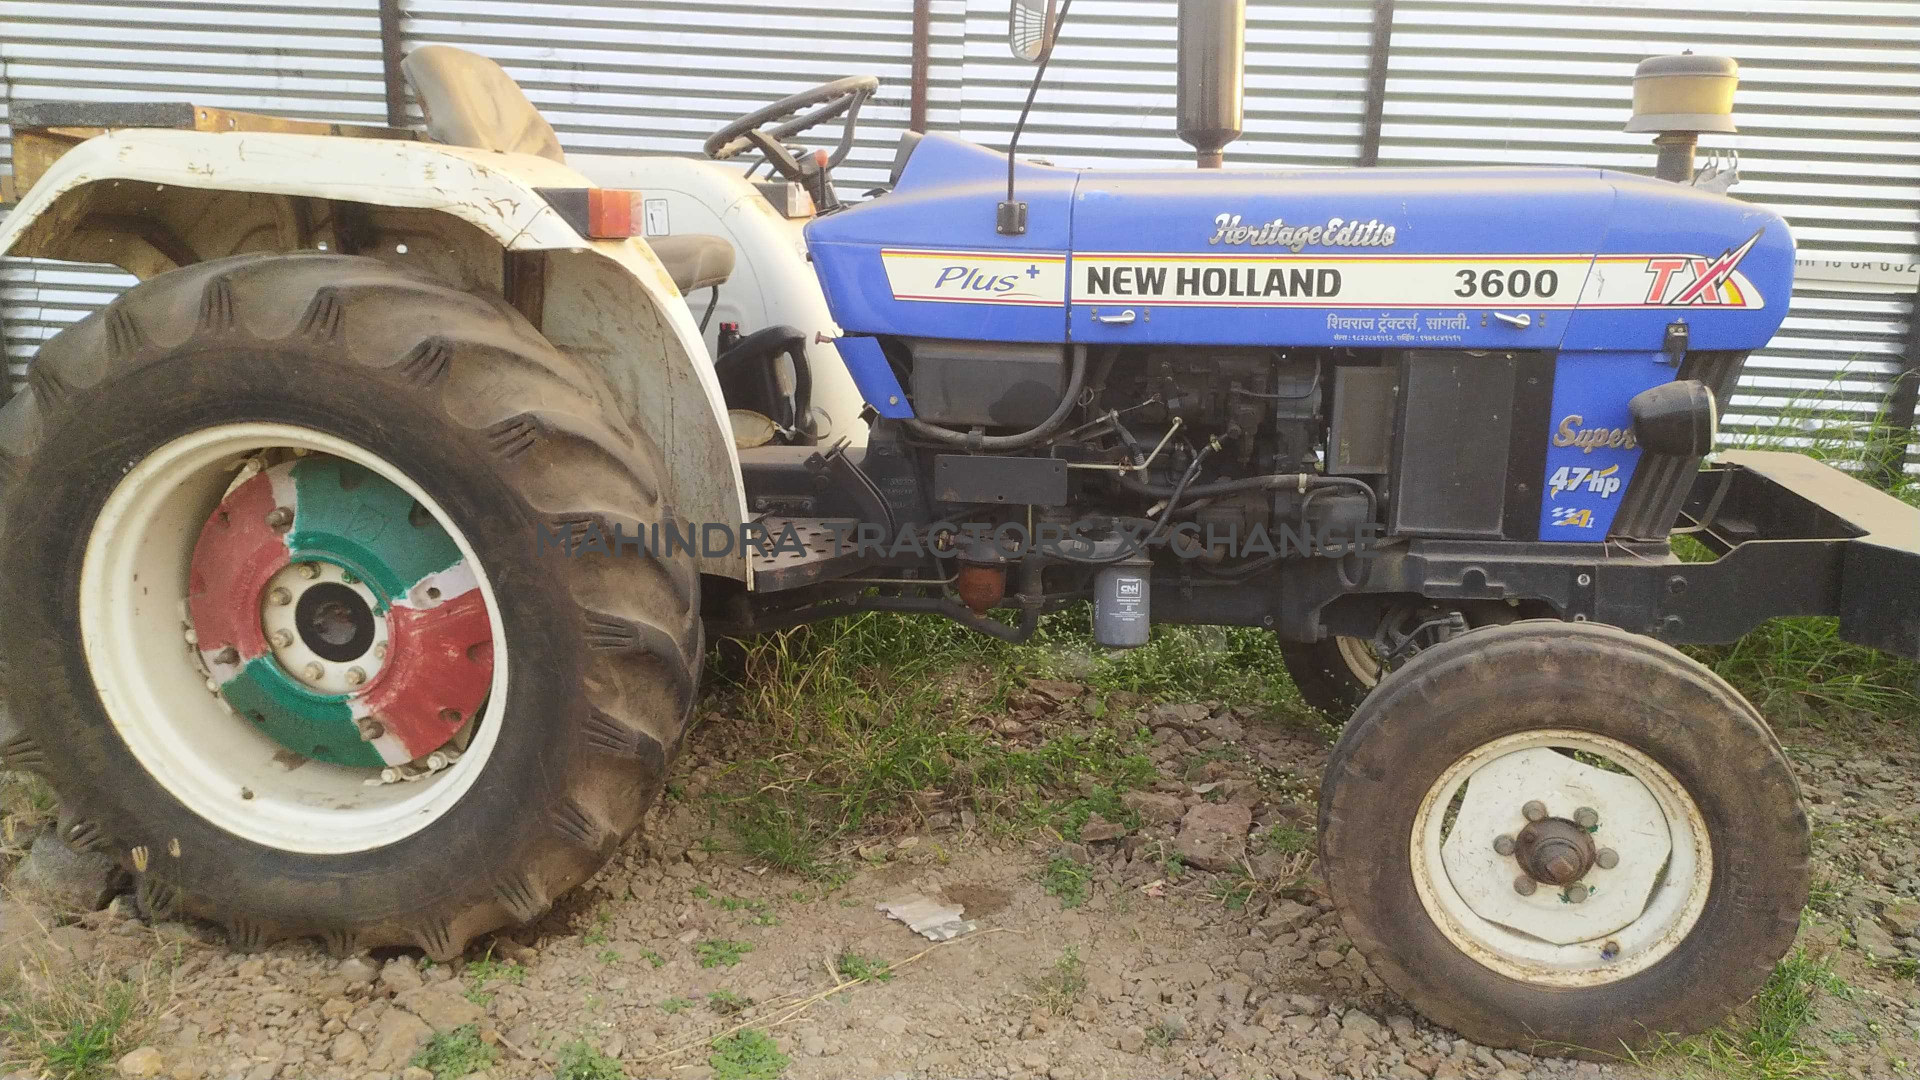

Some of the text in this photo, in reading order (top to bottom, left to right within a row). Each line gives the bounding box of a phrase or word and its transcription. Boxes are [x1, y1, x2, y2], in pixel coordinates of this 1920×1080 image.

[1086, 265, 1343, 298] NEW HOLLAND
[1645, 228, 1764, 306] TX
[1453, 268, 1559, 299] 3600
[1326, 312, 1375, 330] शिवराज
[1553, 414, 1637, 454] Super
[1120, 583, 1139, 592] CNH
